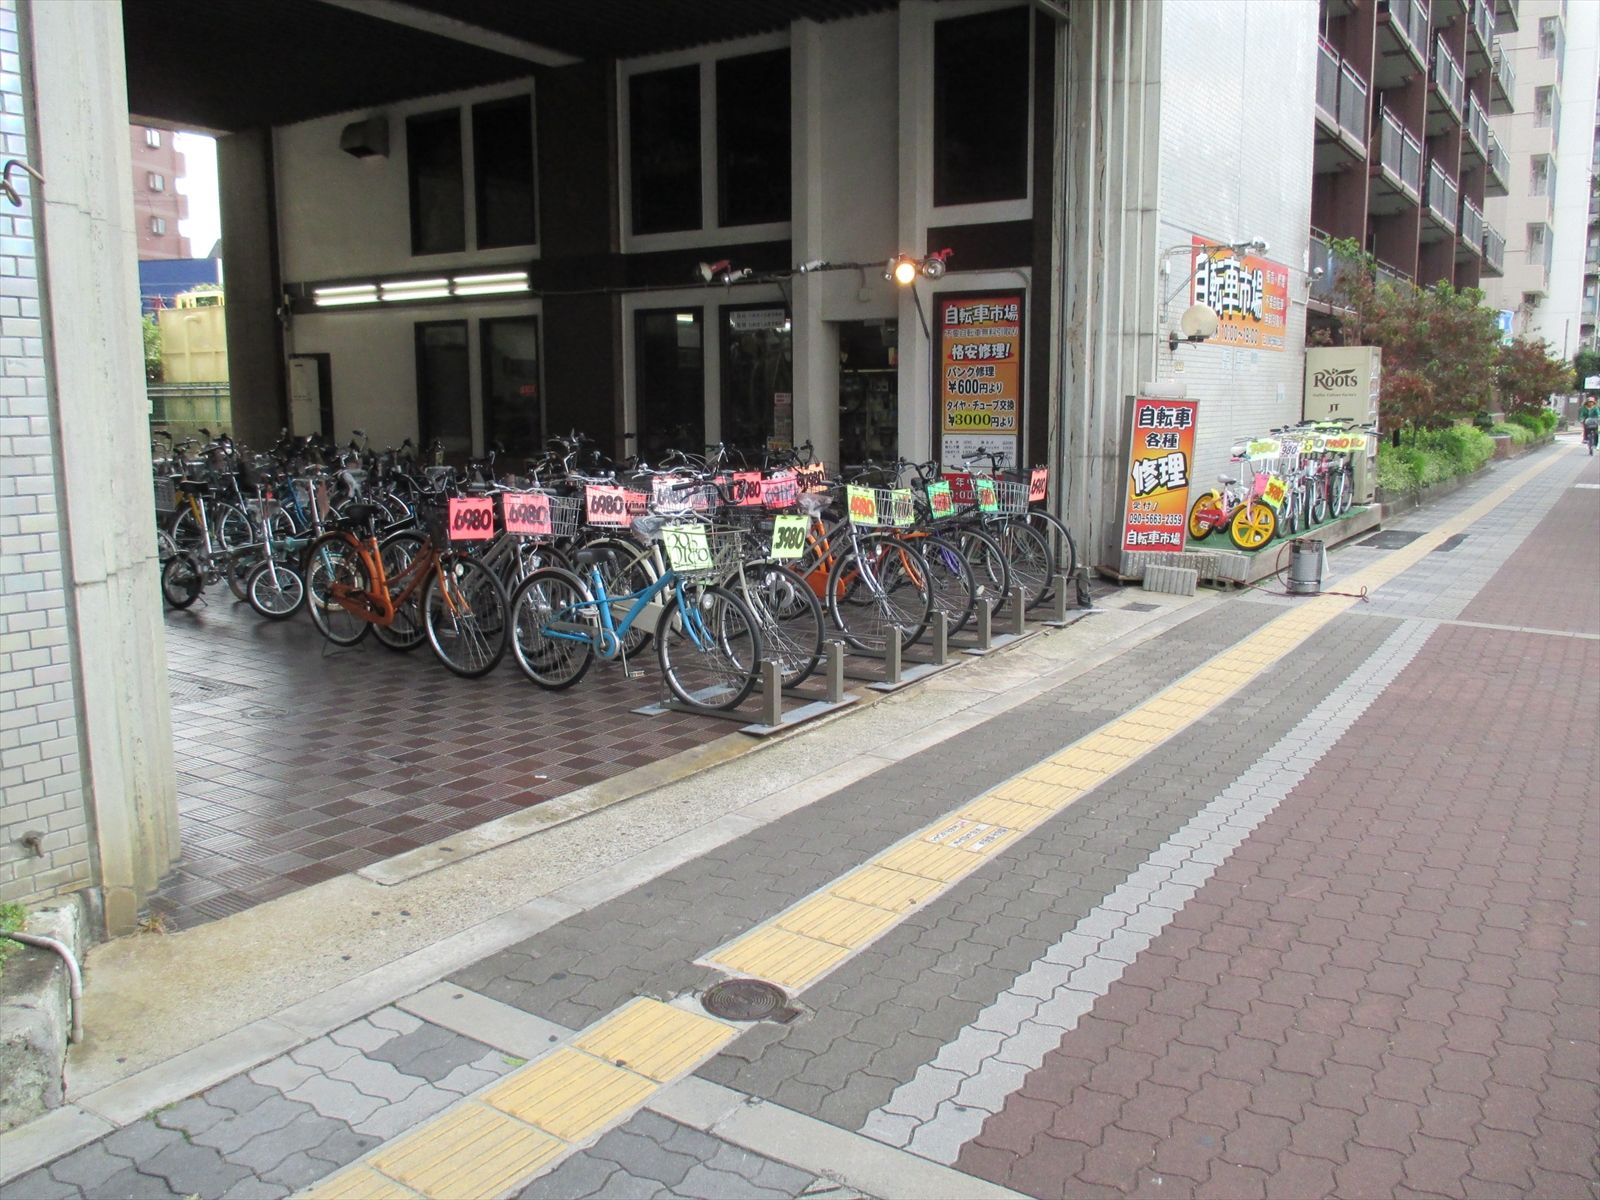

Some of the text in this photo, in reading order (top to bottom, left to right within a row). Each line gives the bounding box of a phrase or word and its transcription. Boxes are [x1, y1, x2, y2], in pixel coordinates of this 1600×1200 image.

[1194, 252, 1263, 321] 自転車市場
[945, 304, 1018, 324] 自転車市場
[1313, 370, 1358, 391] Roots
[1138, 405, 1192, 428] 自転車
[1146, 432, 1179, 448] 各種
[1131, 452, 1188, 497] 修理
[508, 503, 549, 526] 6980
[590, 495, 624, 515] 6980
[453, 508, 492, 531] 6980
[775, 526, 805, 550] 3980
[1126, 530, 1181, 545] 自転車市場
